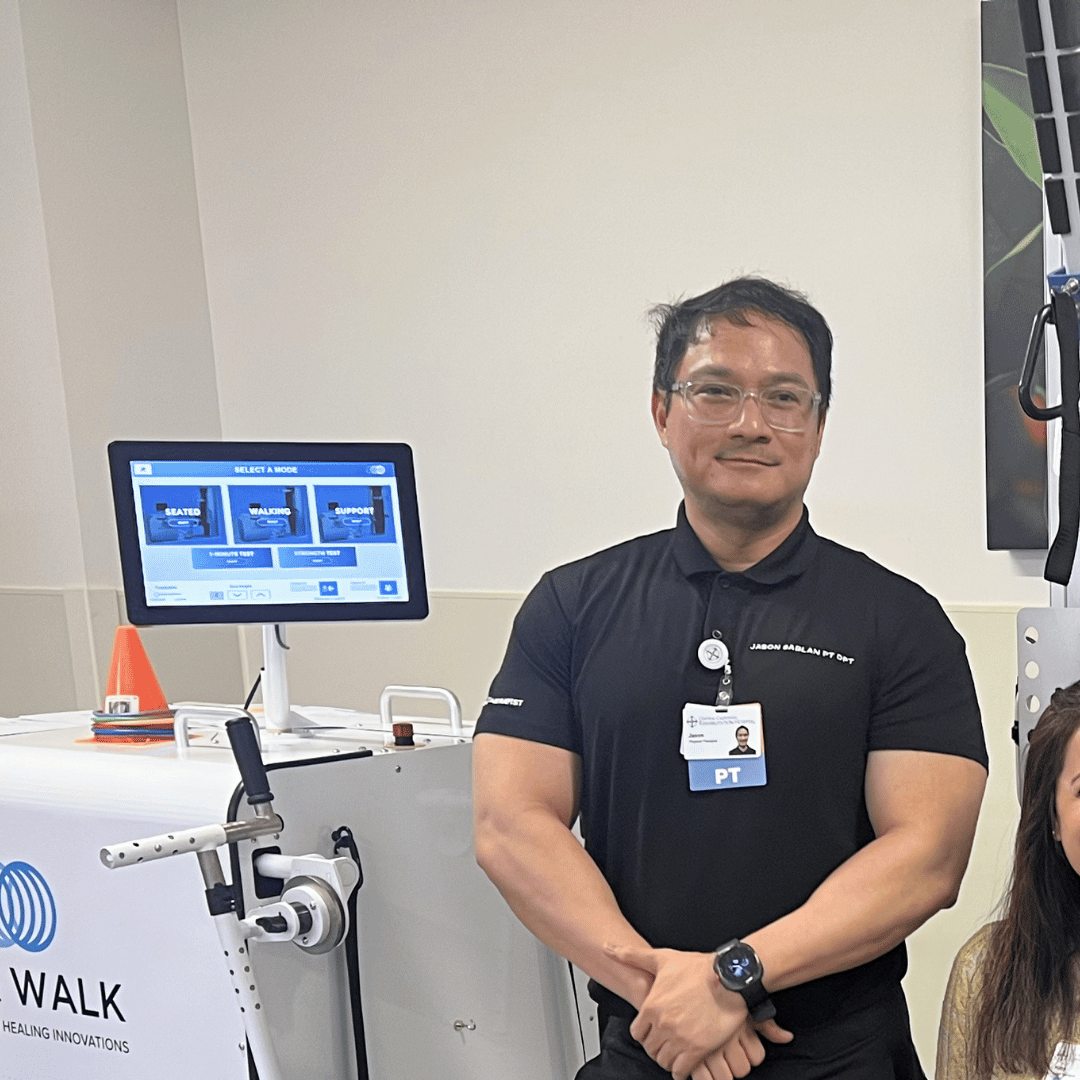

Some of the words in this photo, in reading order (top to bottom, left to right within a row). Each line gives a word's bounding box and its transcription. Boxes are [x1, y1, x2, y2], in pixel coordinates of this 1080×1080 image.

[164, 507, 201, 516] SEATED
[248, 507, 292, 516] WALKING
[335, 506, 374, 516] SUPPORT
[749, 643, 781, 651] JASON
[822, 650, 836, 659] PT
[715, 767, 741, 785] PT
[9, 967, 126, 1022] WALK
[2, 1020, 50, 1039] HEALING
[52, 1028, 130, 1054] INNOVATIONS
